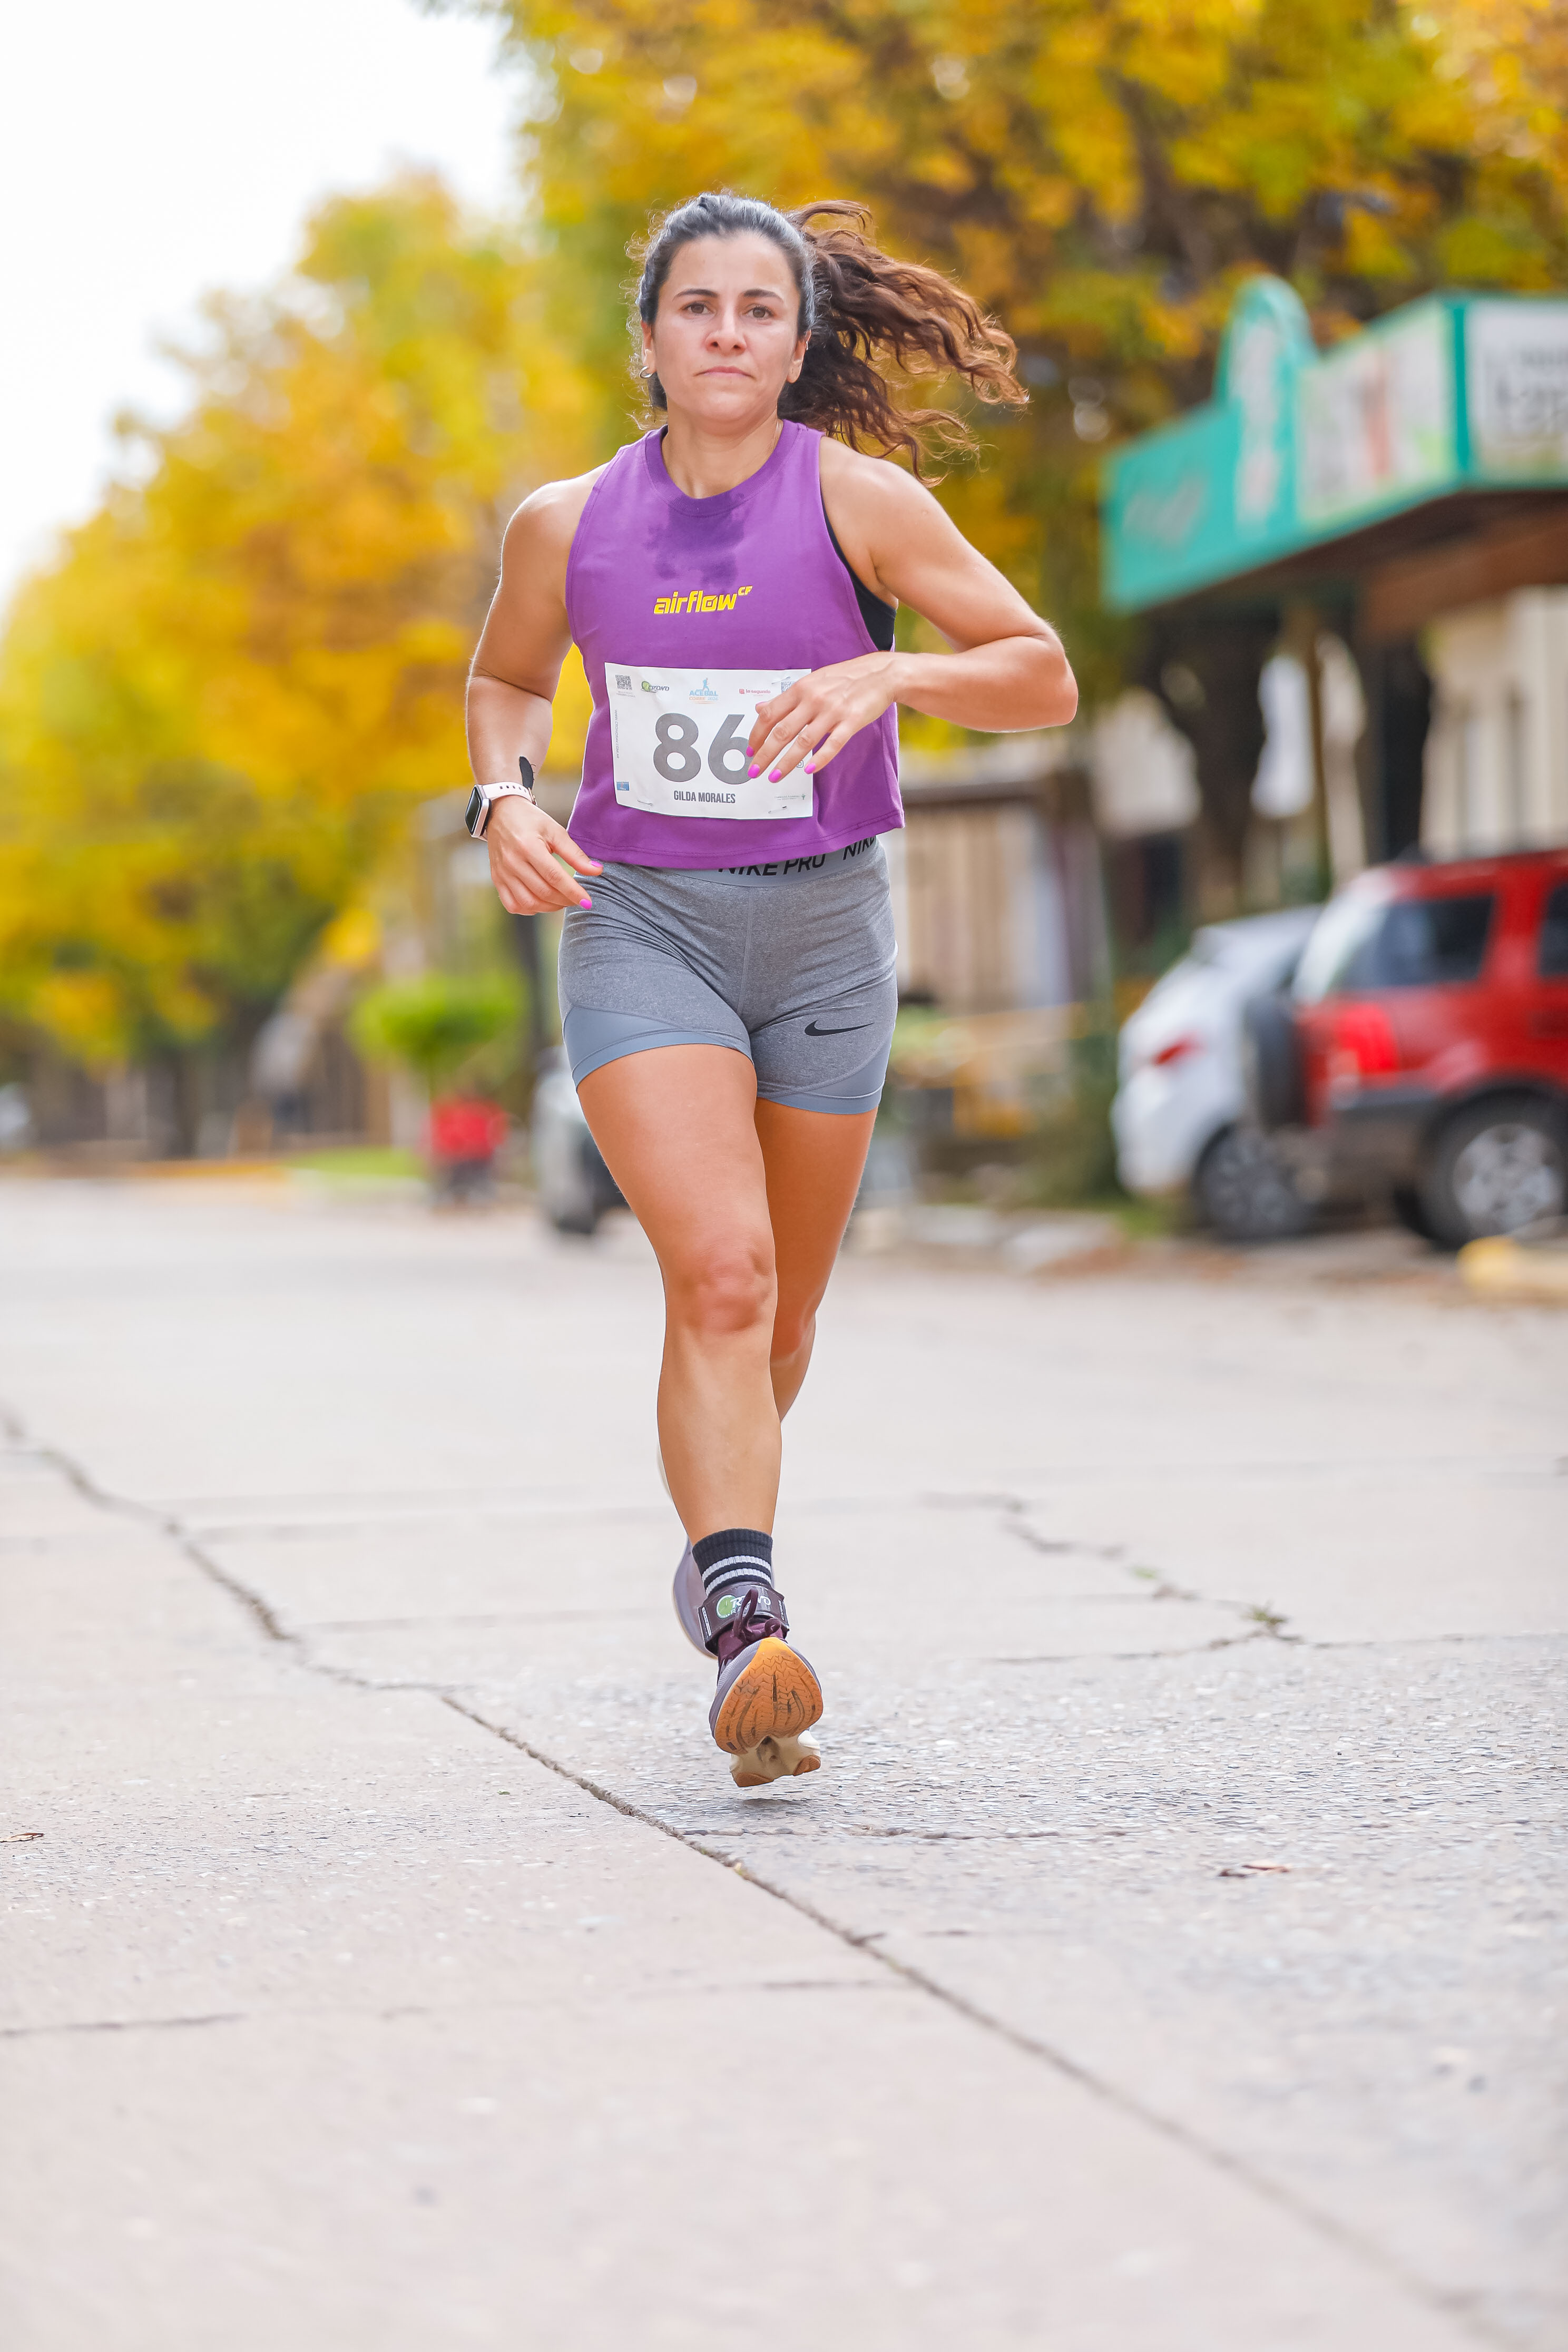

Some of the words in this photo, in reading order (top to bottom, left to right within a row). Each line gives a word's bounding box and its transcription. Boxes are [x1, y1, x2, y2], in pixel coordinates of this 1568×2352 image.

[654, 590, 738, 614] airflow
[653, 712, 754, 785] 86
[674, 790, 696, 801] GILDA
[698, 792, 736, 803] MORALES
